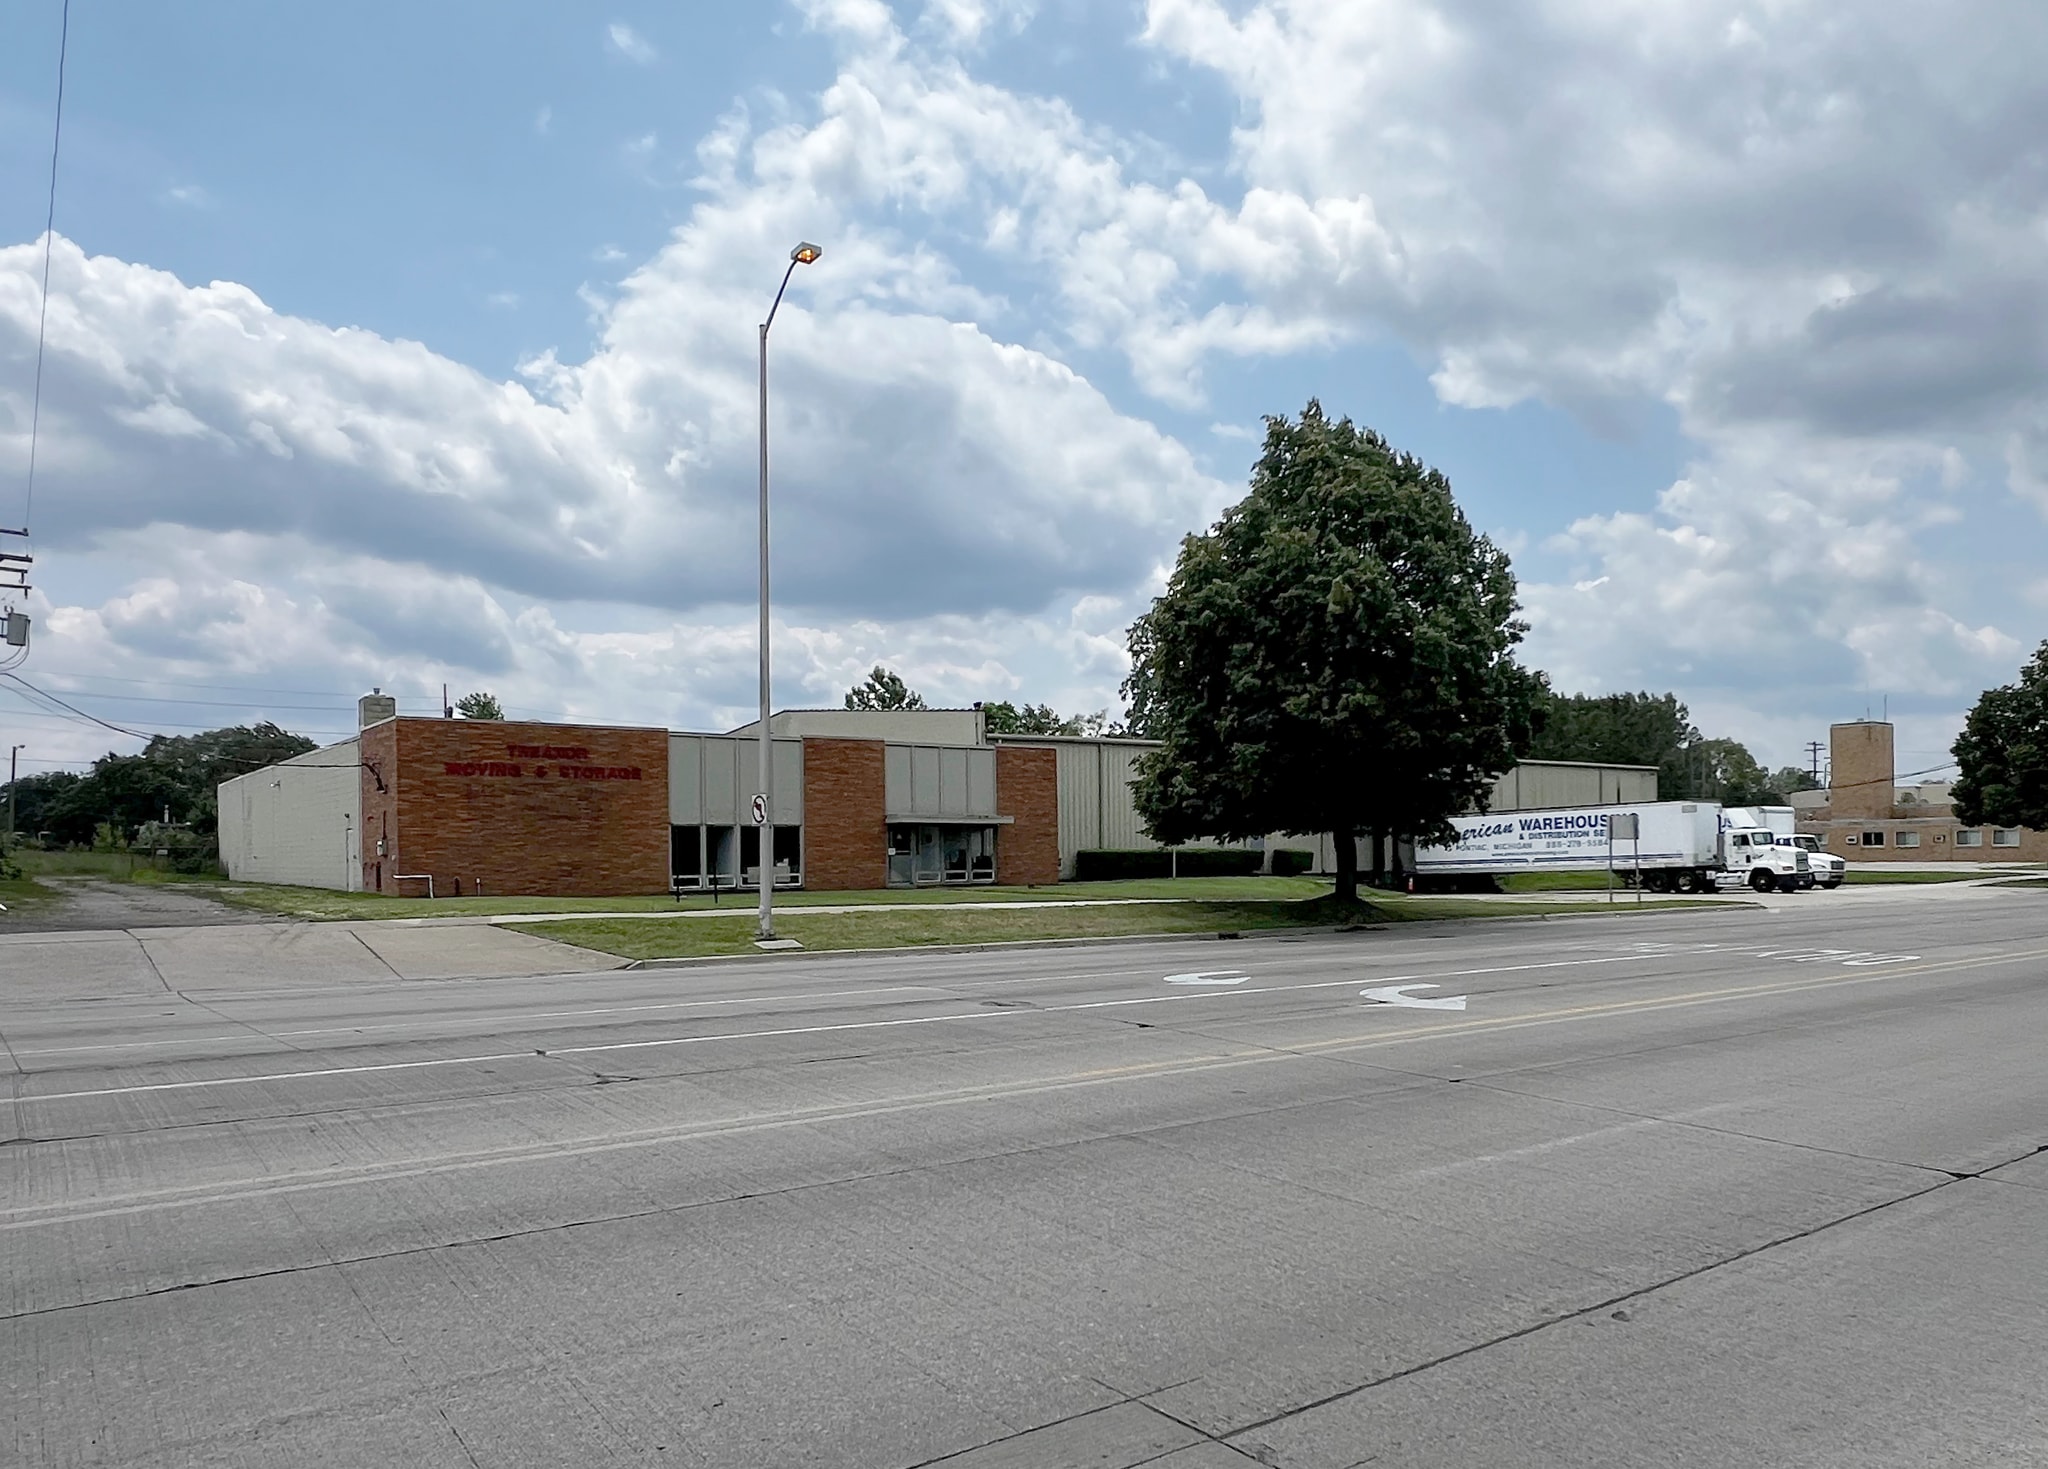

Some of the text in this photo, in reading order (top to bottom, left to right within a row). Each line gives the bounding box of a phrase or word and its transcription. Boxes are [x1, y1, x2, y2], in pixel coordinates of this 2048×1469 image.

[444, 762, 522, 778] MOVING
[559, 765, 642, 781] STORAGE
[1461, 823, 1514, 841] erican
[1528, 830, 1590, 840] DISTRIBUTION
